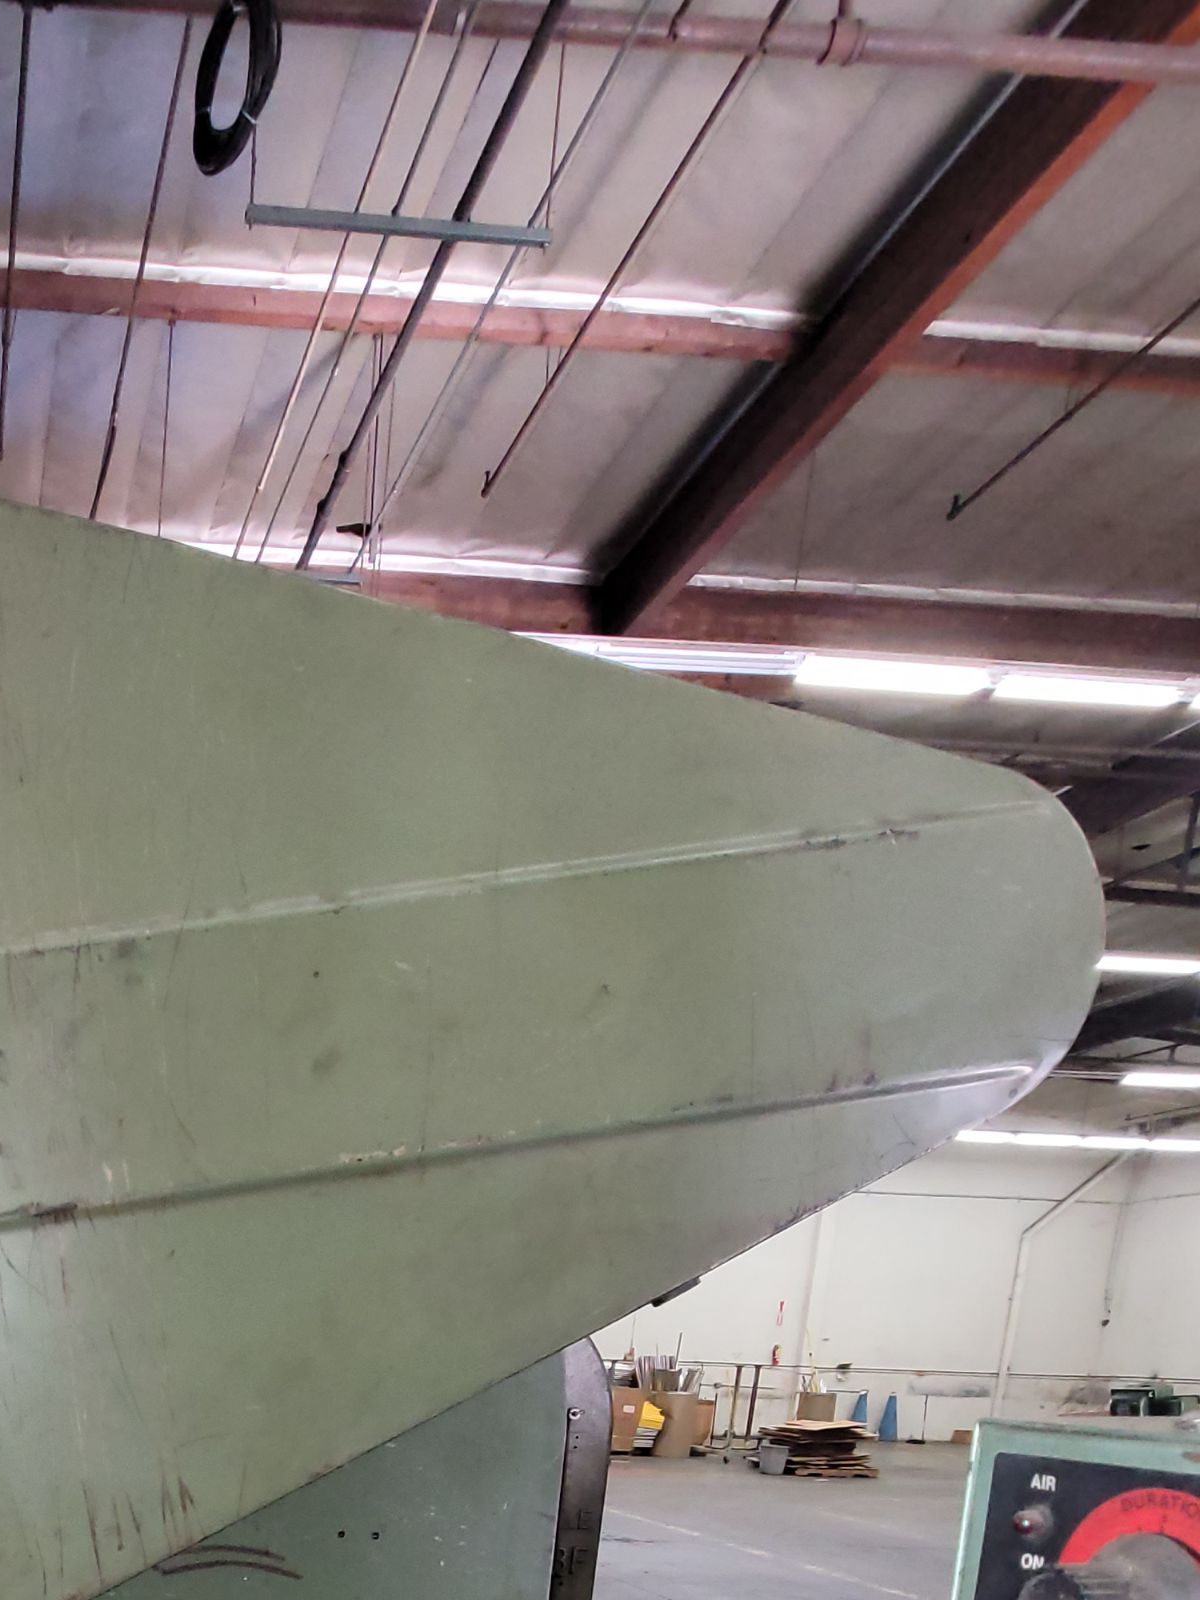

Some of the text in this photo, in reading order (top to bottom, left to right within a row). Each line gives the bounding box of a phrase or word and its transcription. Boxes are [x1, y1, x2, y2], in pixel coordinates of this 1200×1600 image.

[1030, 1473, 1057, 1492] AIR
[1121, 1494, 1200, 1519] DURATIO
[1021, 1553, 1045, 1570] ON
